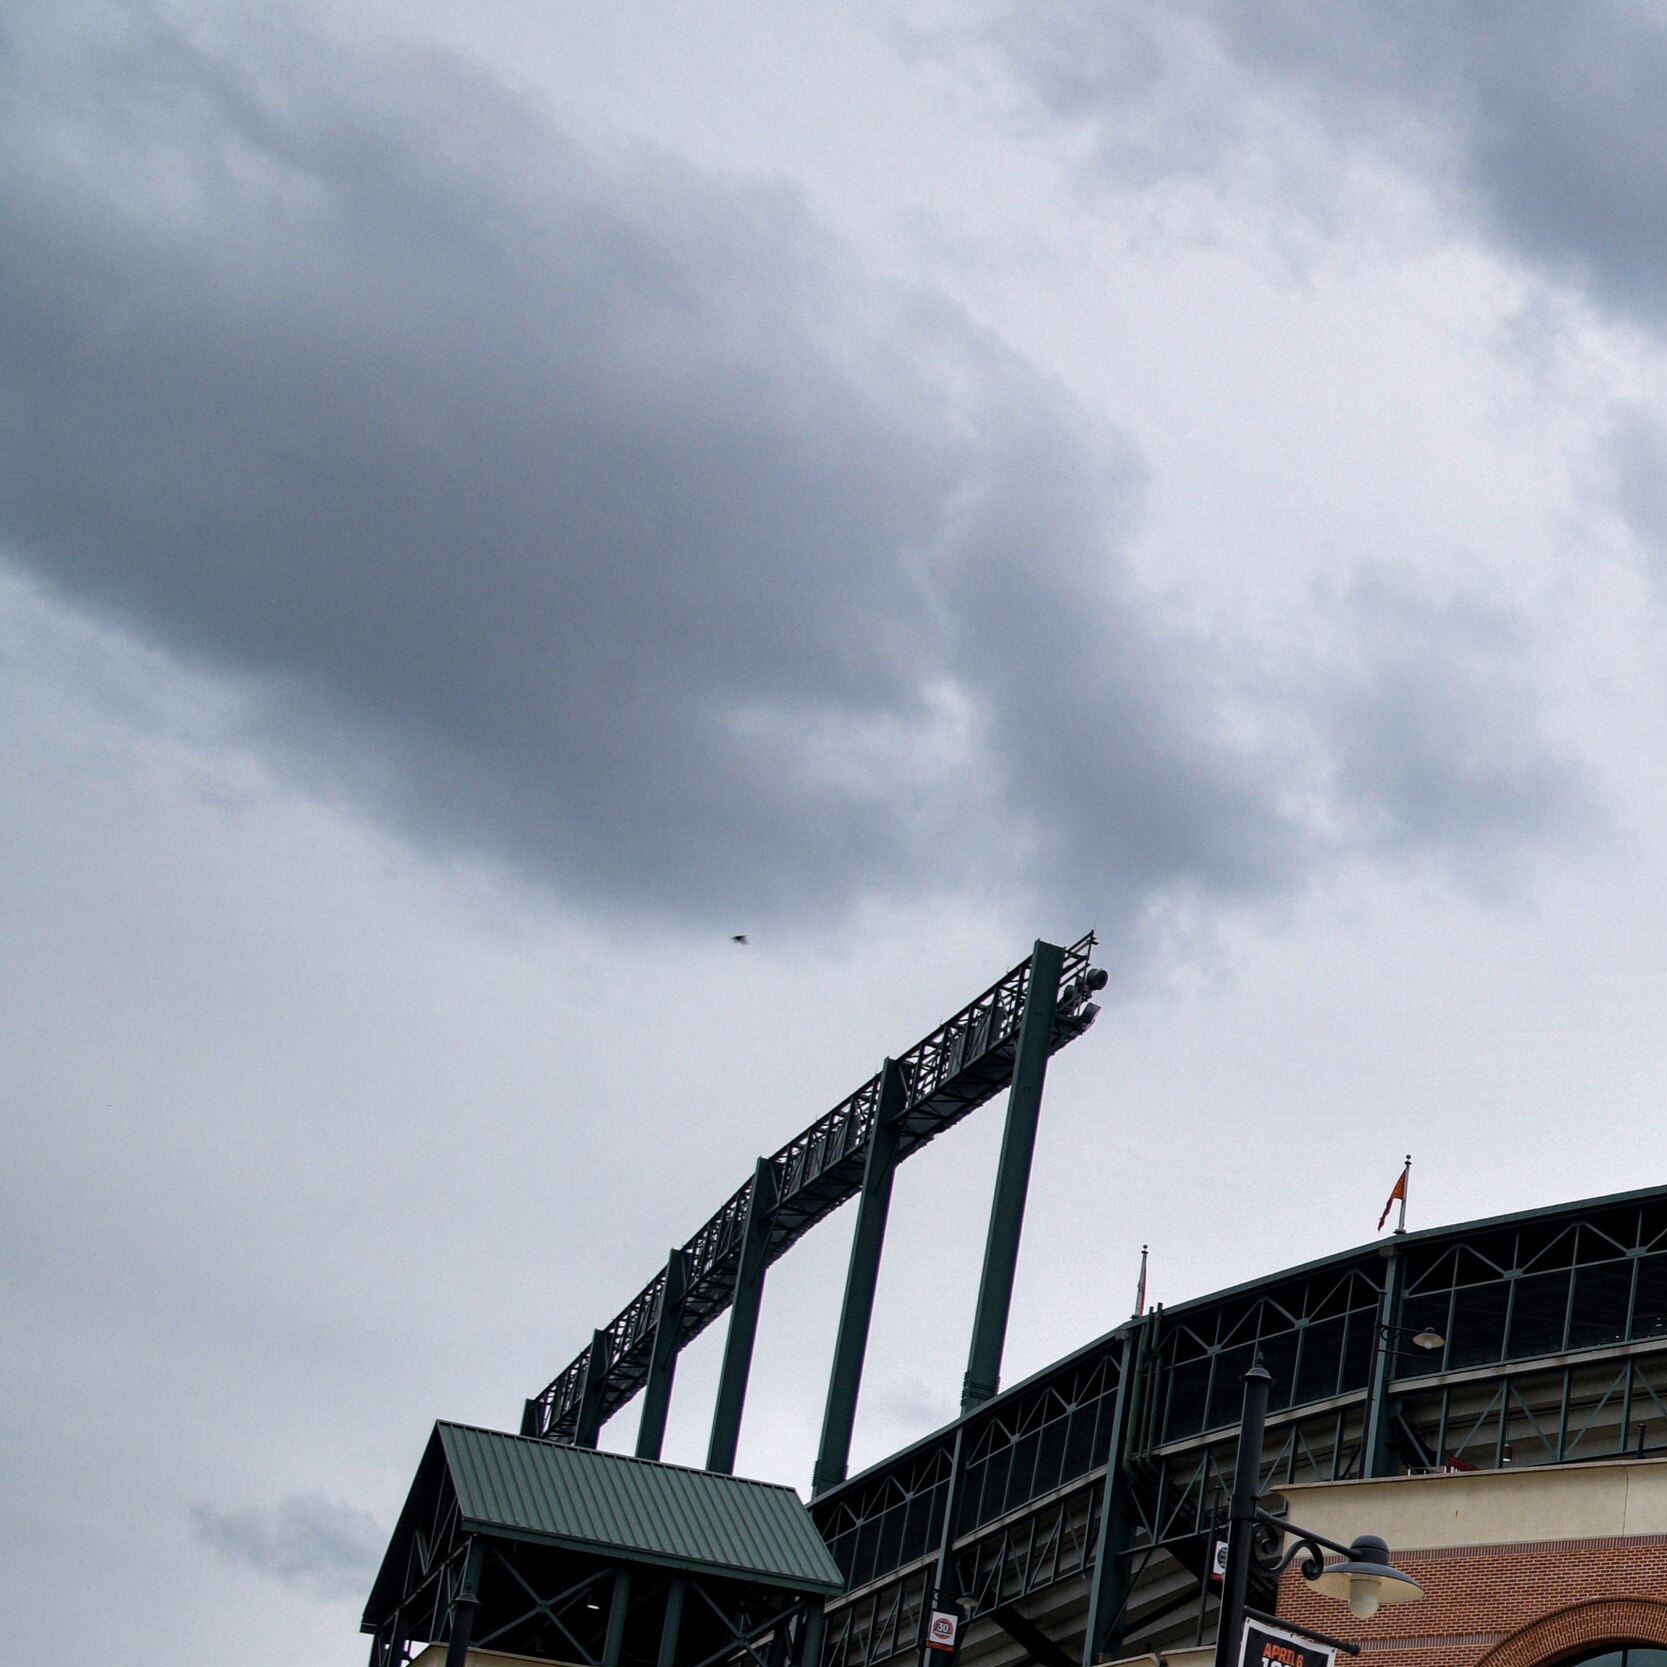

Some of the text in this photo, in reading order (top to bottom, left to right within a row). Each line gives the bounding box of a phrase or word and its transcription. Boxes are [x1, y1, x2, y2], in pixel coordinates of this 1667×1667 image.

[937, 1622, 949, 1633] 30
[1263, 1643, 1305, 1667] APRIL 6
